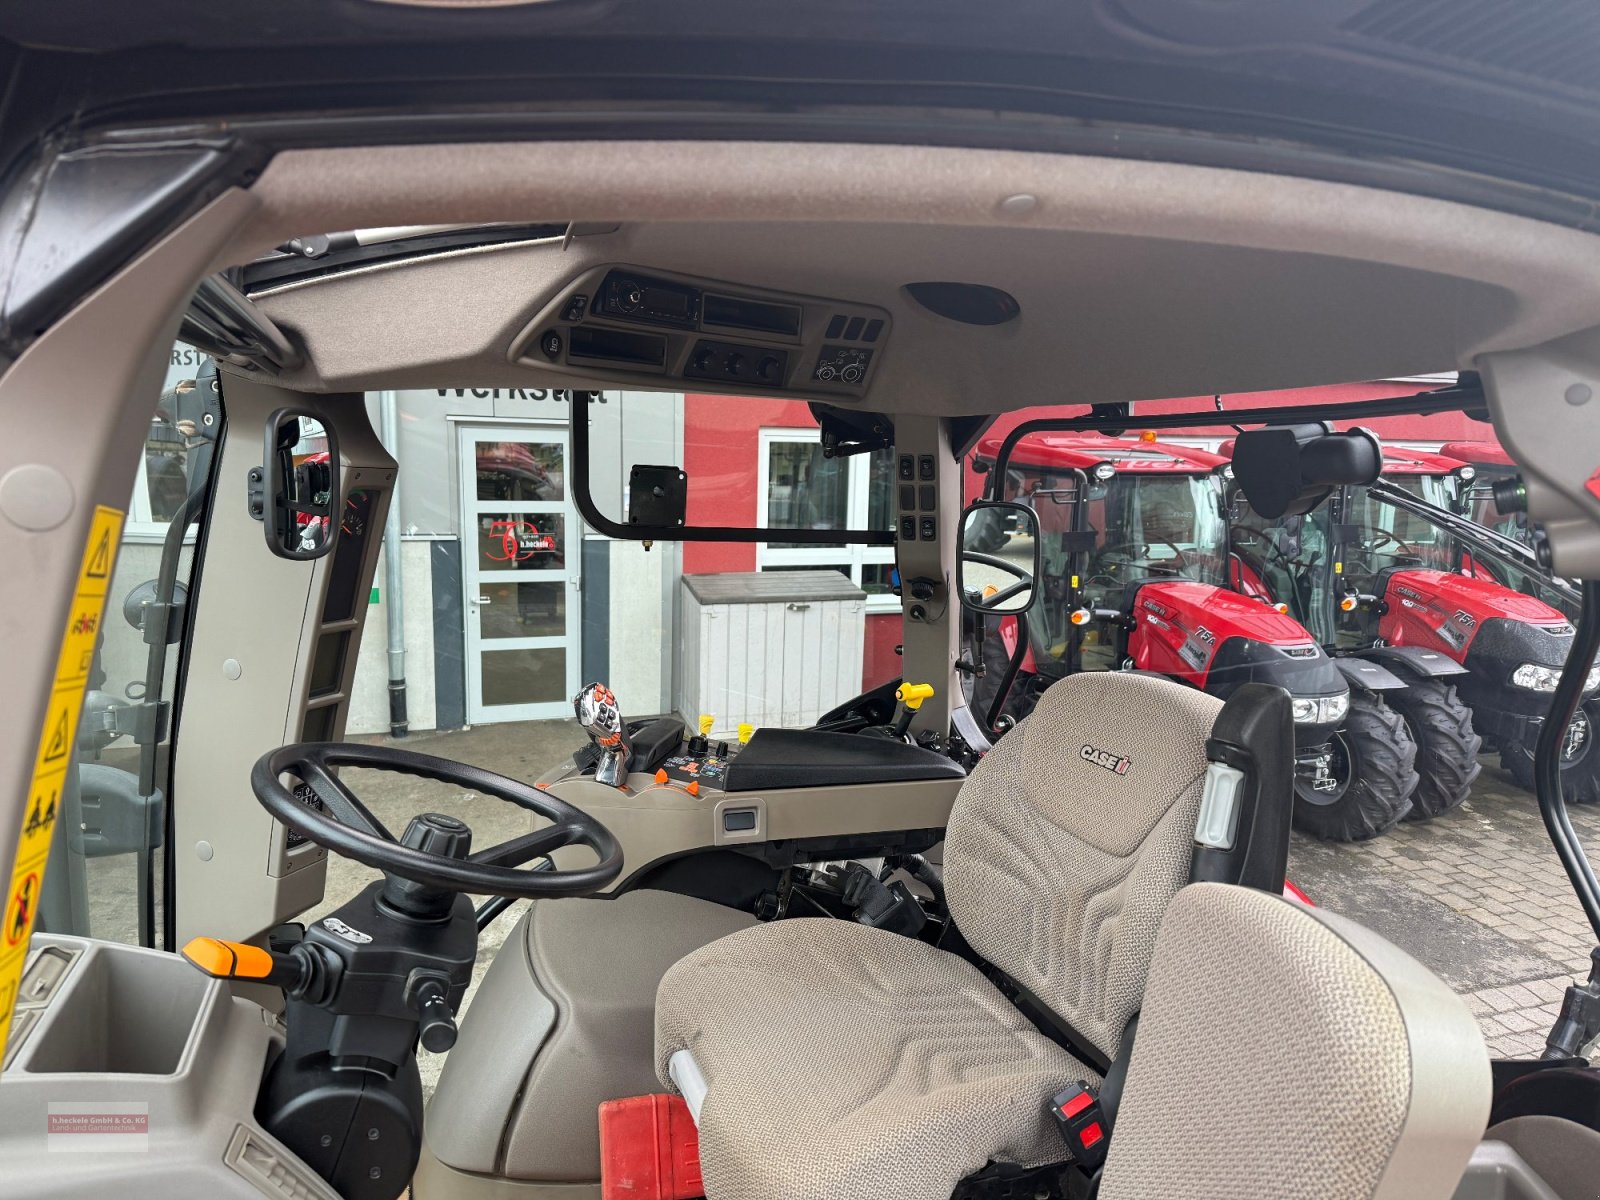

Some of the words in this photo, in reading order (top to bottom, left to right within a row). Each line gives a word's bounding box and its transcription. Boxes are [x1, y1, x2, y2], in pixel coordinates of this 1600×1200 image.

[437, 388, 607, 404] erkstt
[1454, 609, 1476, 628] 75A
[1194, 625, 1216, 645] 75A
[1080, 745, 1119, 770] CASE
